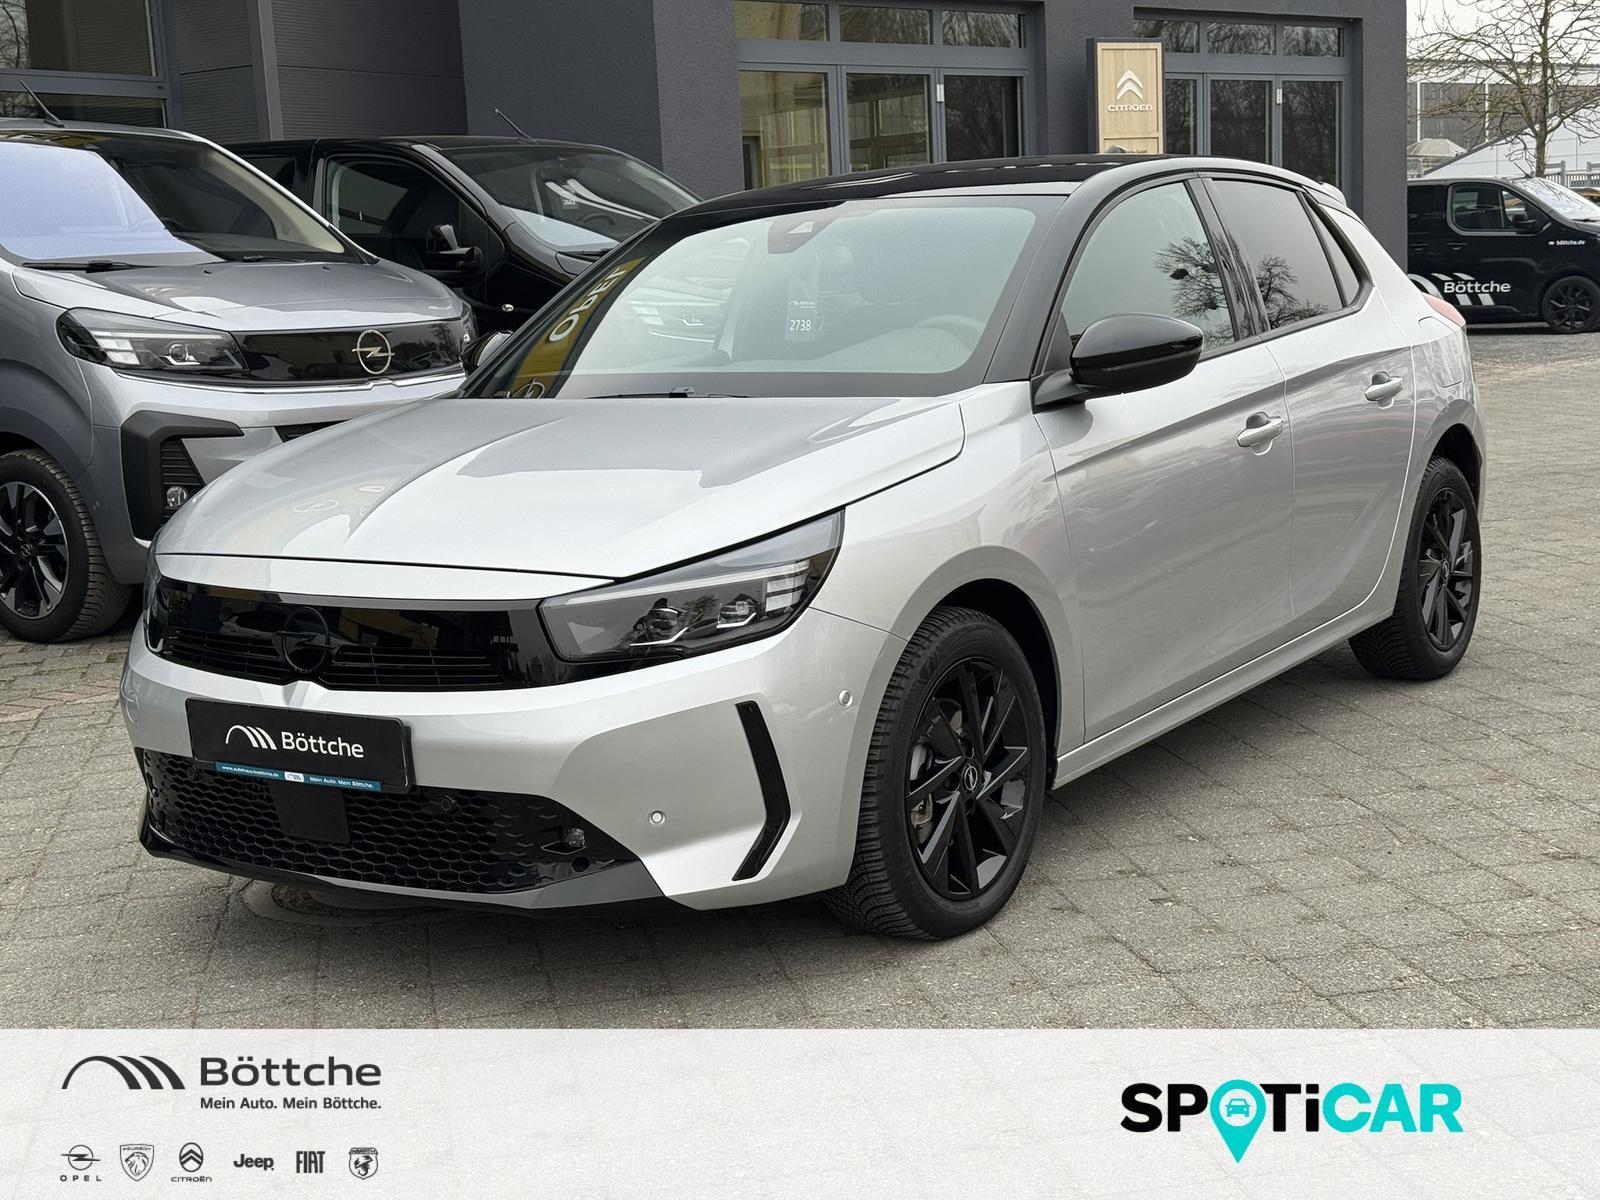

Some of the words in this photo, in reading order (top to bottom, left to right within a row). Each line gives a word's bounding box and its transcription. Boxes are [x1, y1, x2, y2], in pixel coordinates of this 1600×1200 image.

[1443, 280, 1511, 294] Böttche
[789, 319, 812, 331] 2738
[281, 731, 364, 758] Böttche
[337, 779, 352, 787] Mein
